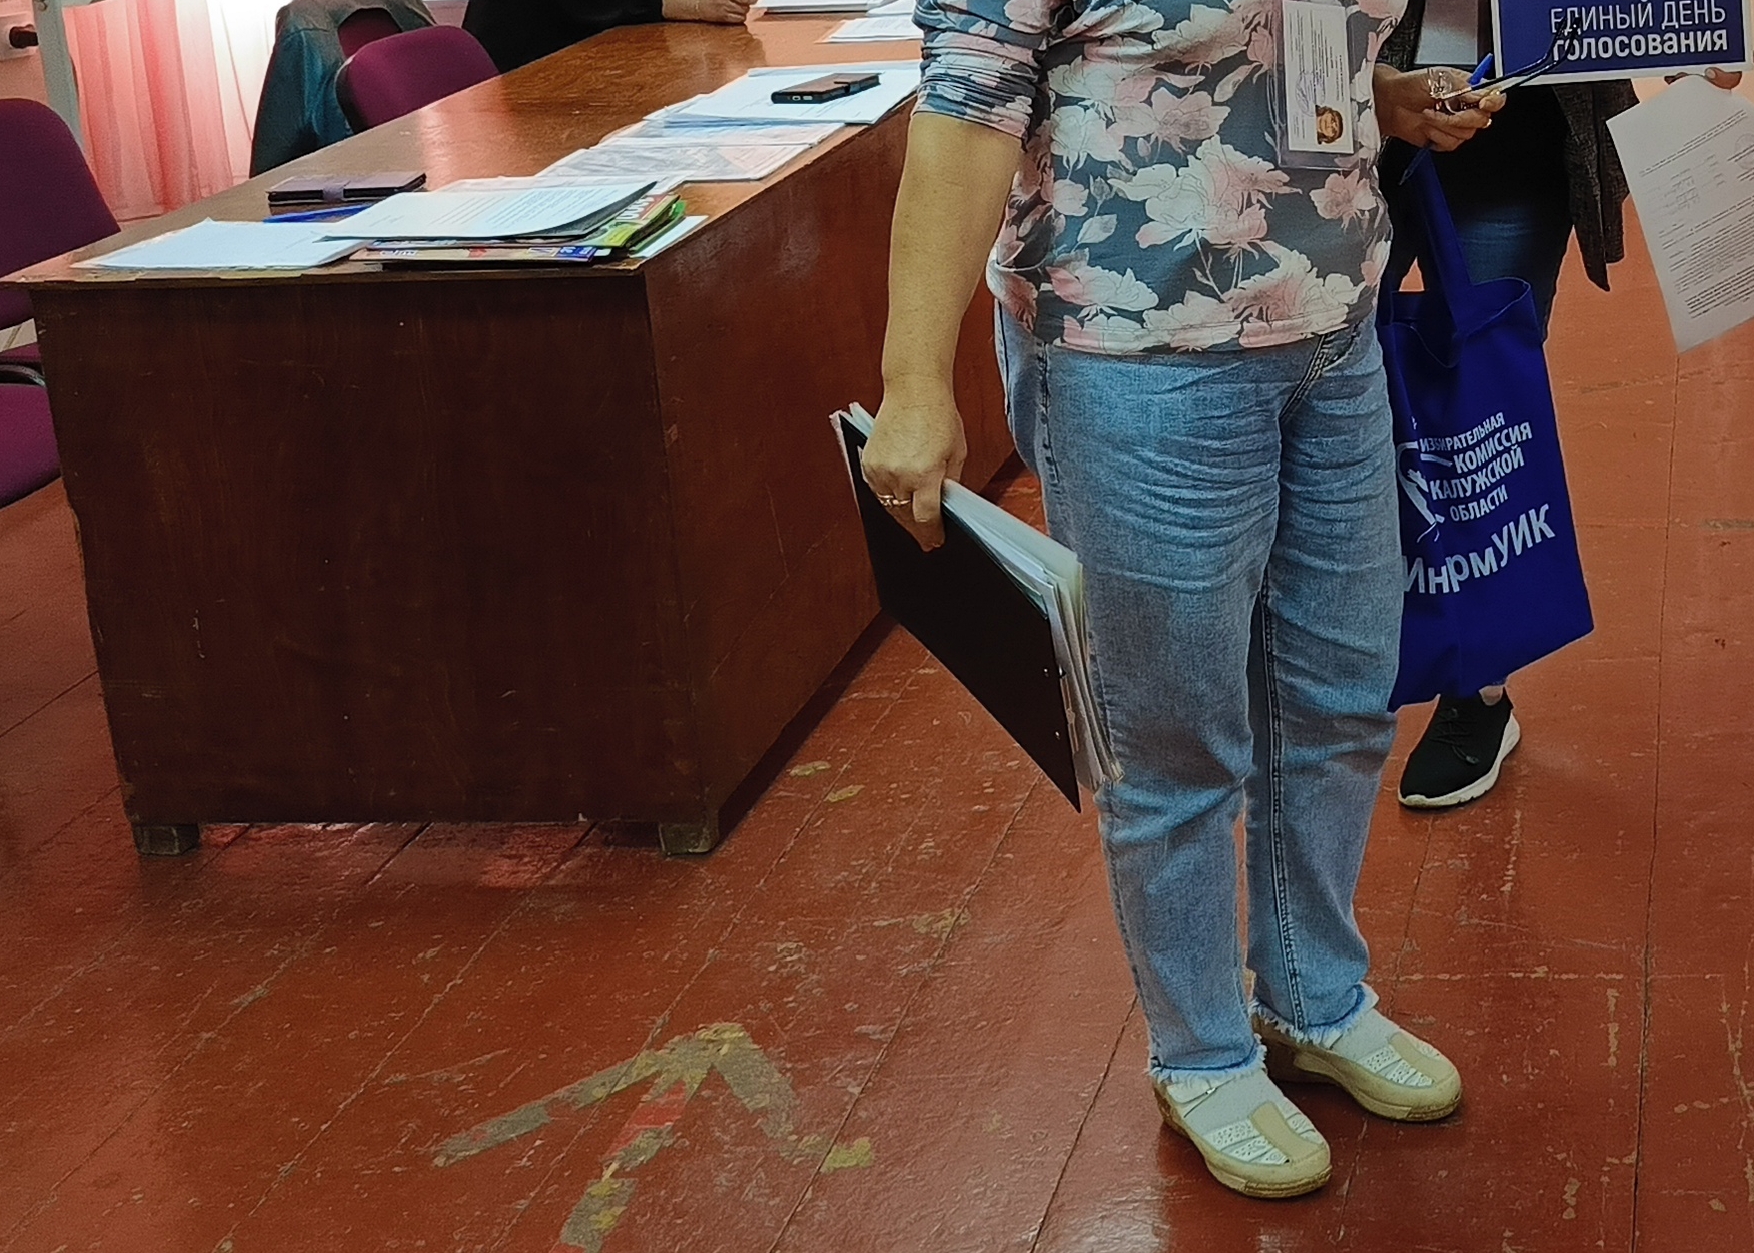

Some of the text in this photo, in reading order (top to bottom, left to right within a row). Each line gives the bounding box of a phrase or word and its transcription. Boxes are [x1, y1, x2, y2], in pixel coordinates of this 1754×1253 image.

[1418, 411, 1506, 453] ИЗБИРАТЕЛЬНАЯ
[1453, 421, 1533, 474] КОМИССИЯ
[1429, 444, 1525, 501] КАЛУЖСКОЙ
[1450, 483, 1509, 523] ОБЛАСТИ
